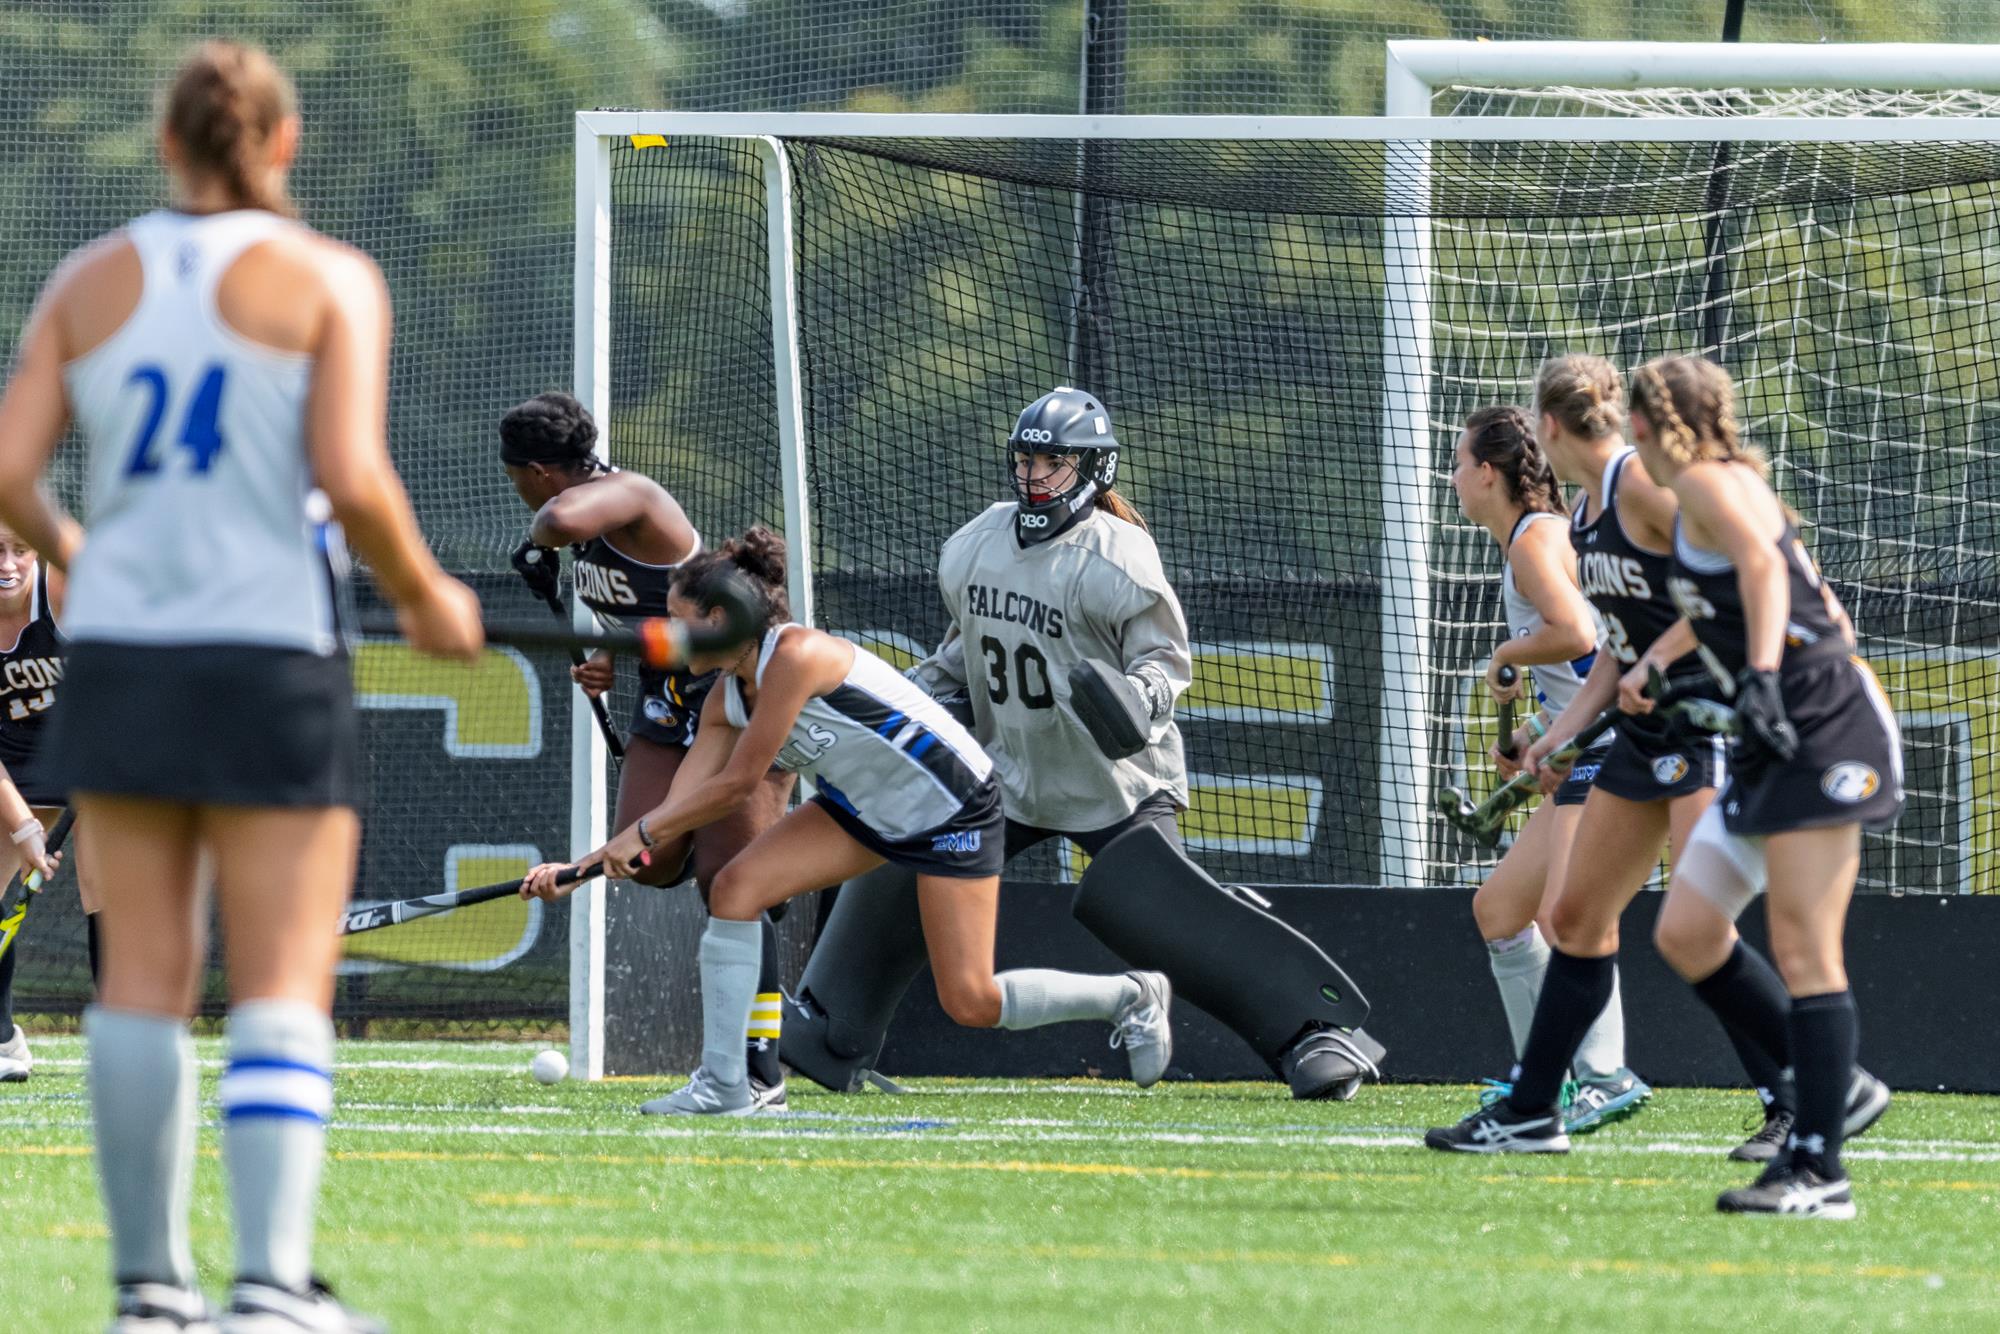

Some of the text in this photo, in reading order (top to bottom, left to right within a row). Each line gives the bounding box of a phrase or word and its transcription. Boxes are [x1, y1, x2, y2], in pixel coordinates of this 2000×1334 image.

[123, 363, 228, 478] 24
[1021, 428, 1052, 443] OBO
[968, 584, 1064, 639] FALCONS
[981, 635, 1055, 710] 30
[930, 830, 983, 852] EMU
